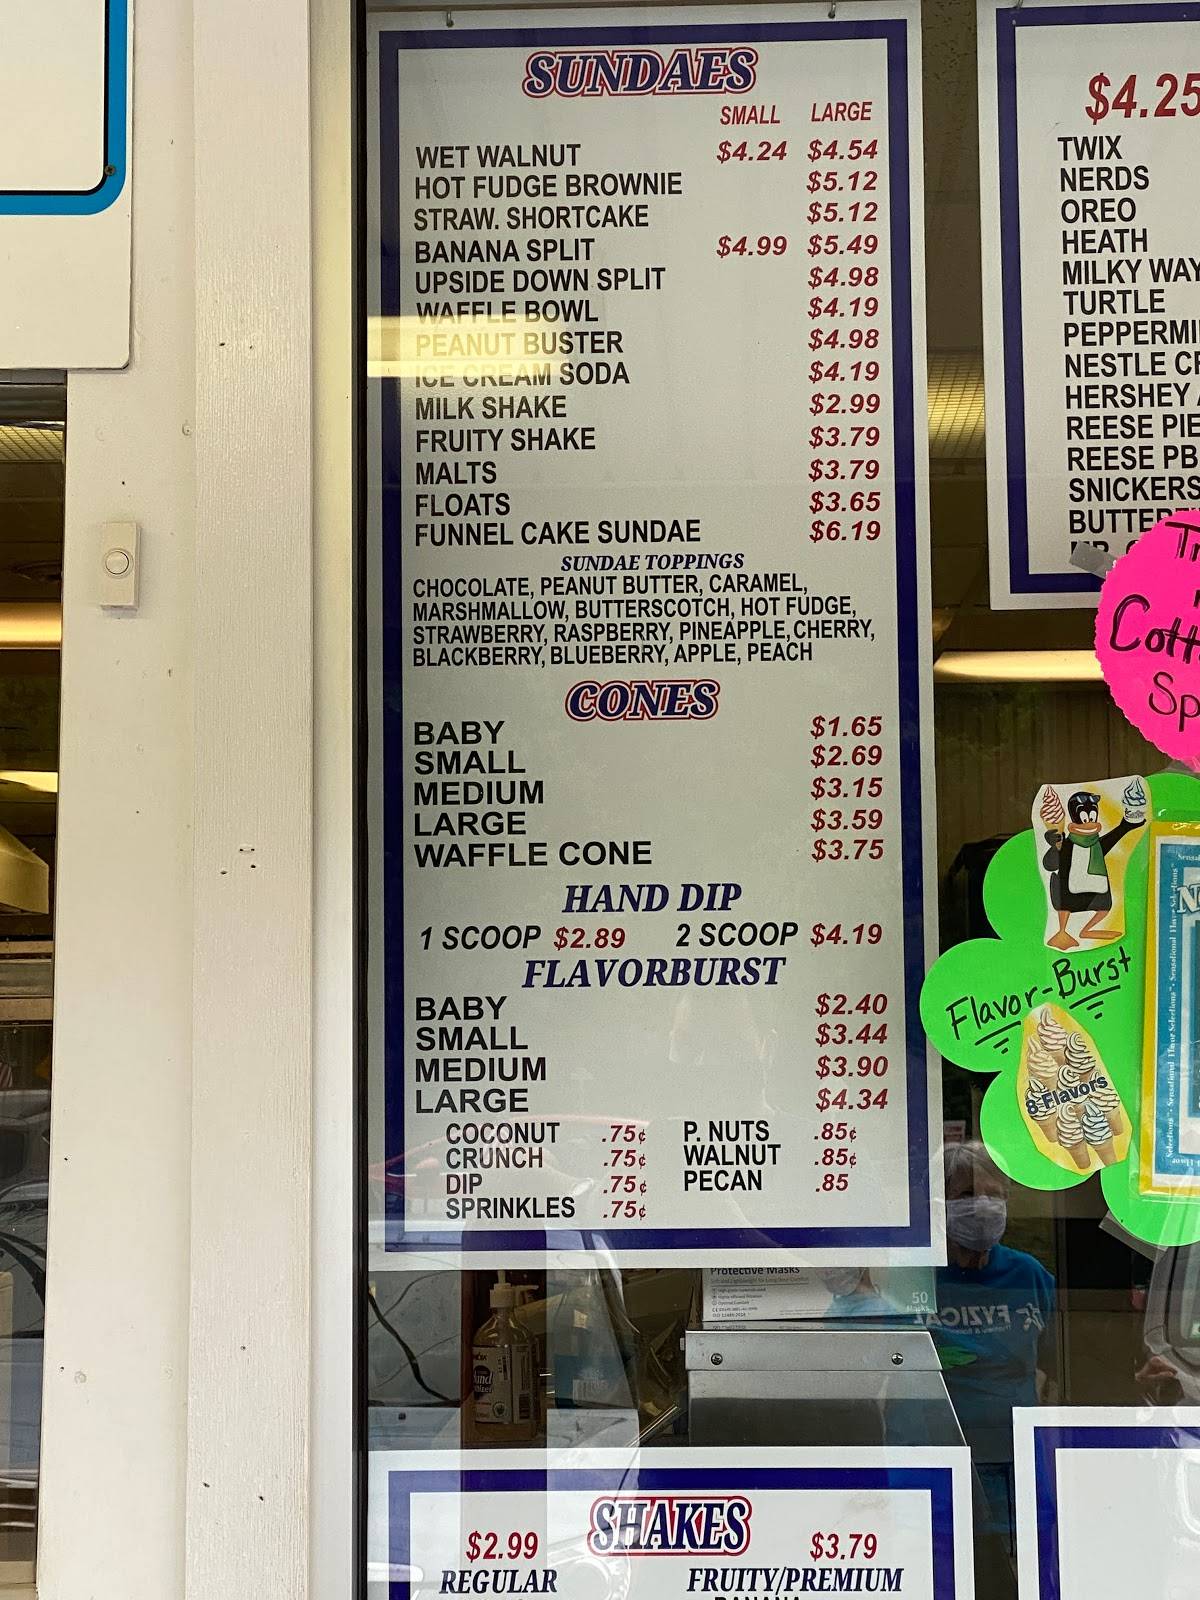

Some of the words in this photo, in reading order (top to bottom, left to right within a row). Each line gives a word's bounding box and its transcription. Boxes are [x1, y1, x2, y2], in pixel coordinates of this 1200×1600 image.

[522, 47, 758, 98] SUNDAES
[1085, 72, 1200, 125] $4.25
[720, 104, 780, 126] SMALL
[810, 102, 872, 122] LARGE
[416, 146, 470, 168] WET
[476, 144, 582, 168] WALNUT
[716, 140, 788, 164] $4.24
[806, 138, 878, 164] $4.54
[1056, 134, 1124, 162] TWIX
[416, 176, 466, 200] HOT
[474, 174, 558, 198] FUDGE
[566, 172, 682, 196] BROWNIE
[806, 170, 878, 194] $5.12
[1060, 164, 1150, 192] NERDS
[414, 206, 500, 232] STRAW.
[506, 204, 650, 230] SHORTCAKE
[806, 200, 878, 226] $5.12
[1060, 196, 1136, 224] OREO
[416, 240, 520, 264] BANANA
[526, 238, 596, 262] SPLIT
[716, 234, 788, 258] $4.99
[806, 234, 878, 258] $5.49
[1062, 228, 1148, 254] HEATH
[416, 270, 504, 294] UPSIDE
[512, 268, 588, 292] DOWN
[596, 266, 666, 292] SPLIT
[808, 266, 880, 290] $4.98
[1062, 258, 1142, 286] MILKY
[1149, 258, 1200, 282] WAY
[416, 300, 516, 324] WAFFLE
[524, 300, 598, 322] BOWL
[808, 296, 878, 320] $4.19
[1062, 288, 1166, 316] TURTLE
[417, 333, 515, 357] PEANUT
[524, 331, 623, 355] BUSTER
[808, 328, 880, 352] $4.98
[1064, 319, 1200, 346] PEPPERMI
[415, 364, 455, 387] ICE
[463, 363, 552, 386] CREAM
[560, 362, 630, 386] SODA
[808, 360, 880, 384] $4.19
[1064, 352, 1166, 378] NESTLE
[416, 396, 474, 420] MILK
[482, 394, 568, 420] SHAKE
[808, 392, 880, 416] $2.99
[1066, 382, 1190, 410] HERSHEY
[416, 428, 504, 452] FRUITY
[510, 426, 596, 452] SHAKE
[808, 426, 880, 450] $3.79
[1066, 414, 1154, 440] REESE
[416, 460, 496, 486] MALTS
[808, 458, 880, 482] $3.79
[1068, 446, 1154, 472] REESE
[1164, 444, 1198, 470] PB
[416, 492, 510, 516] FLOATS
[808, 490, 880, 514] $3.65
[1069, 476, 1200, 502] SNICKERS
[416, 522, 514, 546] FUNNEL
[520, 520, 590, 546] CAKE
[598, 518, 700, 544] SUNDAE
[808, 520, 880, 544] $6.19
[560, 554, 640, 572] SUNDAE
[644, 552, 744, 570] TOPPINGS
[412, 576, 534, 600] CHOCOLATE,
[540, 576, 618, 596] PEANUT
[622, 574, 704, 596] BUTTER,
[708, 572, 808, 596] CARAMEL,
[414, 600, 568, 624] MARSHMALLOW,
[576, 598, 734, 620] BUTTERSCOTCH,
[742, 596, 780, 616] HOT
[786, 596, 856, 618] FUDGE,
[414, 624, 548, 646] STRAWBERRY,
[554, 622, 674, 644] RASPBERRY,
[1109, 593, 1200, 664] Cott
[414, 646, 546, 668] BLACKBERRY,
[550, 644, 668, 666] BLUEBERRY,
[674, 642, 742, 666] APPLE,
[748, 642, 812, 662] PEACH
[565, 679, 720, 721] CONES
[414, 720, 506, 746] BABY
[810, 714, 882, 740] $1.65
[414, 750, 526, 776] SMALL
[810, 744, 882, 768] $2.69
[414, 780, 544, 806] MEDIUM
[810, 776, 882, 800] $3.15
[414, 810, 526, 836] LARGE
[810, 808, 882, 832] $3.59
[414, 842, 548, 868] WAFFLE
[558, 840, 652, 866] CONE
[810, 838, 884, 864] $3.75
[562, 884, 670, 914] HAND
[676, 882, 742, 912] DIP
[420, 926, 432, 950] 1
[442, 924, 542, 950] SCOOP
[554, 926, 626, 952] $2.89
[676, 922, 690, 948] 2
[698, 922, 798, 948] SCOOP
[810, 922, 882, 948] $4.19
[520, 956, 786, 988] FLAVORBURST
[416, 996, 508, 1020] BABY
[814, 992, 888, 1018] $2.40
[946, 946, 1131, 1040] Flavor-Burst
[416, 1026, 528, 1052] SMALL
[814, 1022, 888, 1048] $3.44
[416, 1056, 546, 1082] MEDIUM
[816, 1054, 888, 1080] $3.90
[416, 1088, 528, 1114] LARGE
[816, 1088, 888, 1112] $4.34
[1042, 1074, 1108, 1109] Flavors
[446, 1123, 560, 1145] COCONUT
[684, 1120, 700, 1142] P.
[708, 1120, 770, 1142] NUTS
[446, 1147, 543, 1169] CRUNCH
[682, 1144, 782, 1166] WALNUT
[446, 1172, 482, 1194] DIP
[684, 1170, 762, 1192] PECAN
[816, 1174, 848, 1192] .85
[446, 1196, 576, 1220] SPRINKLES
[912, 1291, 928, 1304] 50
[587, 1496, 752, 1556] SHAKES
[466, 1531, 538, 1560] $2.99
[810, 1533, 878, 1561] $3.79
[439, 1568, 557, 1594] REGULAR
[686, 1566, 904, 1593] FRUITY/PREMIUM
